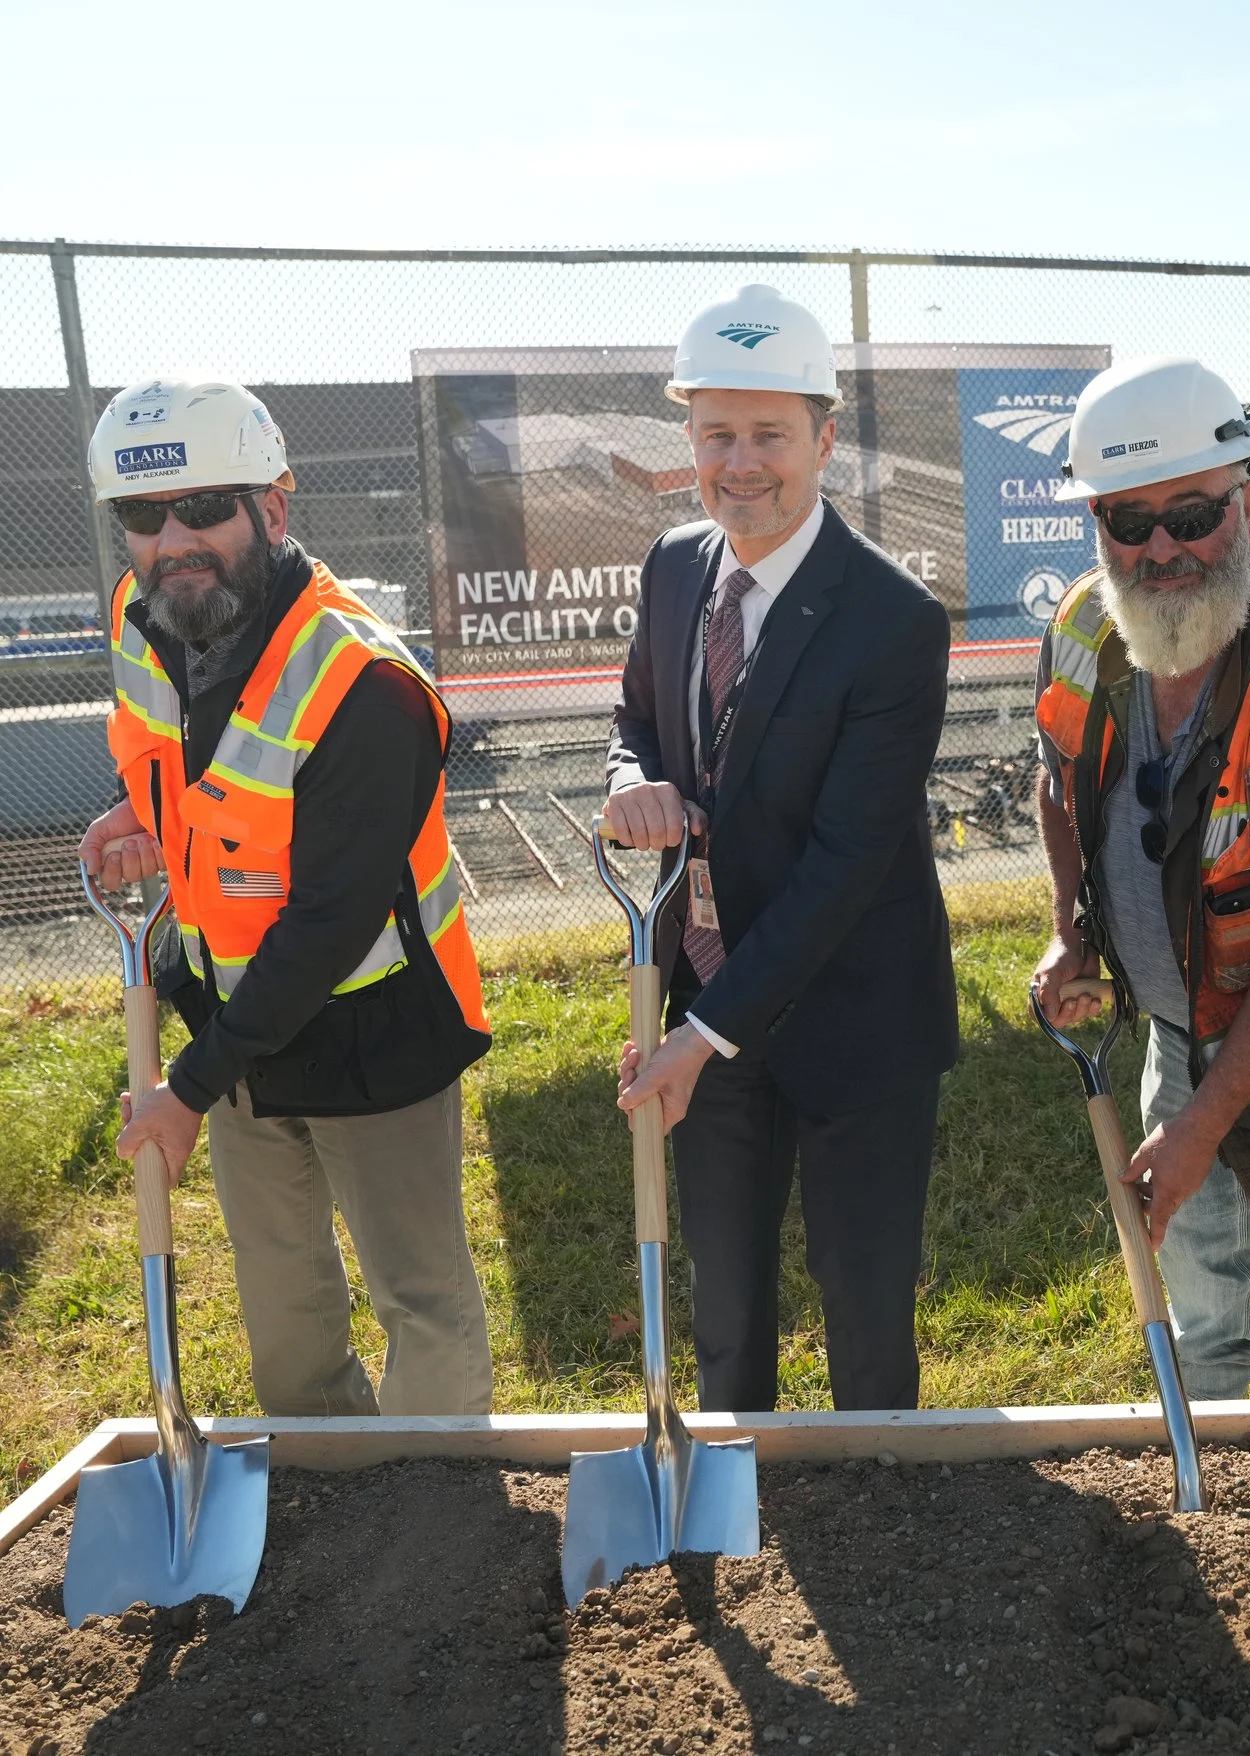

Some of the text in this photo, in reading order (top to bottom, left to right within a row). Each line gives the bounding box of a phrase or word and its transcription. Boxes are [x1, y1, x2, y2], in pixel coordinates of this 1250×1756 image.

[728, 323, 780, 331] AMTRAK
[996, 395, 1079, 406] AMTRA
[118, 446, 182, 466] CLARK
[1102, 445, 1125, 456] CLARK
[1128, 440, 1159, 452] HERZOG
[119, 461, 185, 473] FOUNDATIONS
[143, 469, 181, 479] ALEXANDER
[1000, 479, 1062, 499] CLAR
[1001, 516, 1084, 543] HERZOG
[457, 569, 538, 604] NEW
[546, 564, 643, 600] AMTR
[460, 605, 638, 646] FACILITY O
[463, 645, 629, 664] IVY CITY RAIL YARD WASH
[712, 706, 734, 752] AMTRAK
